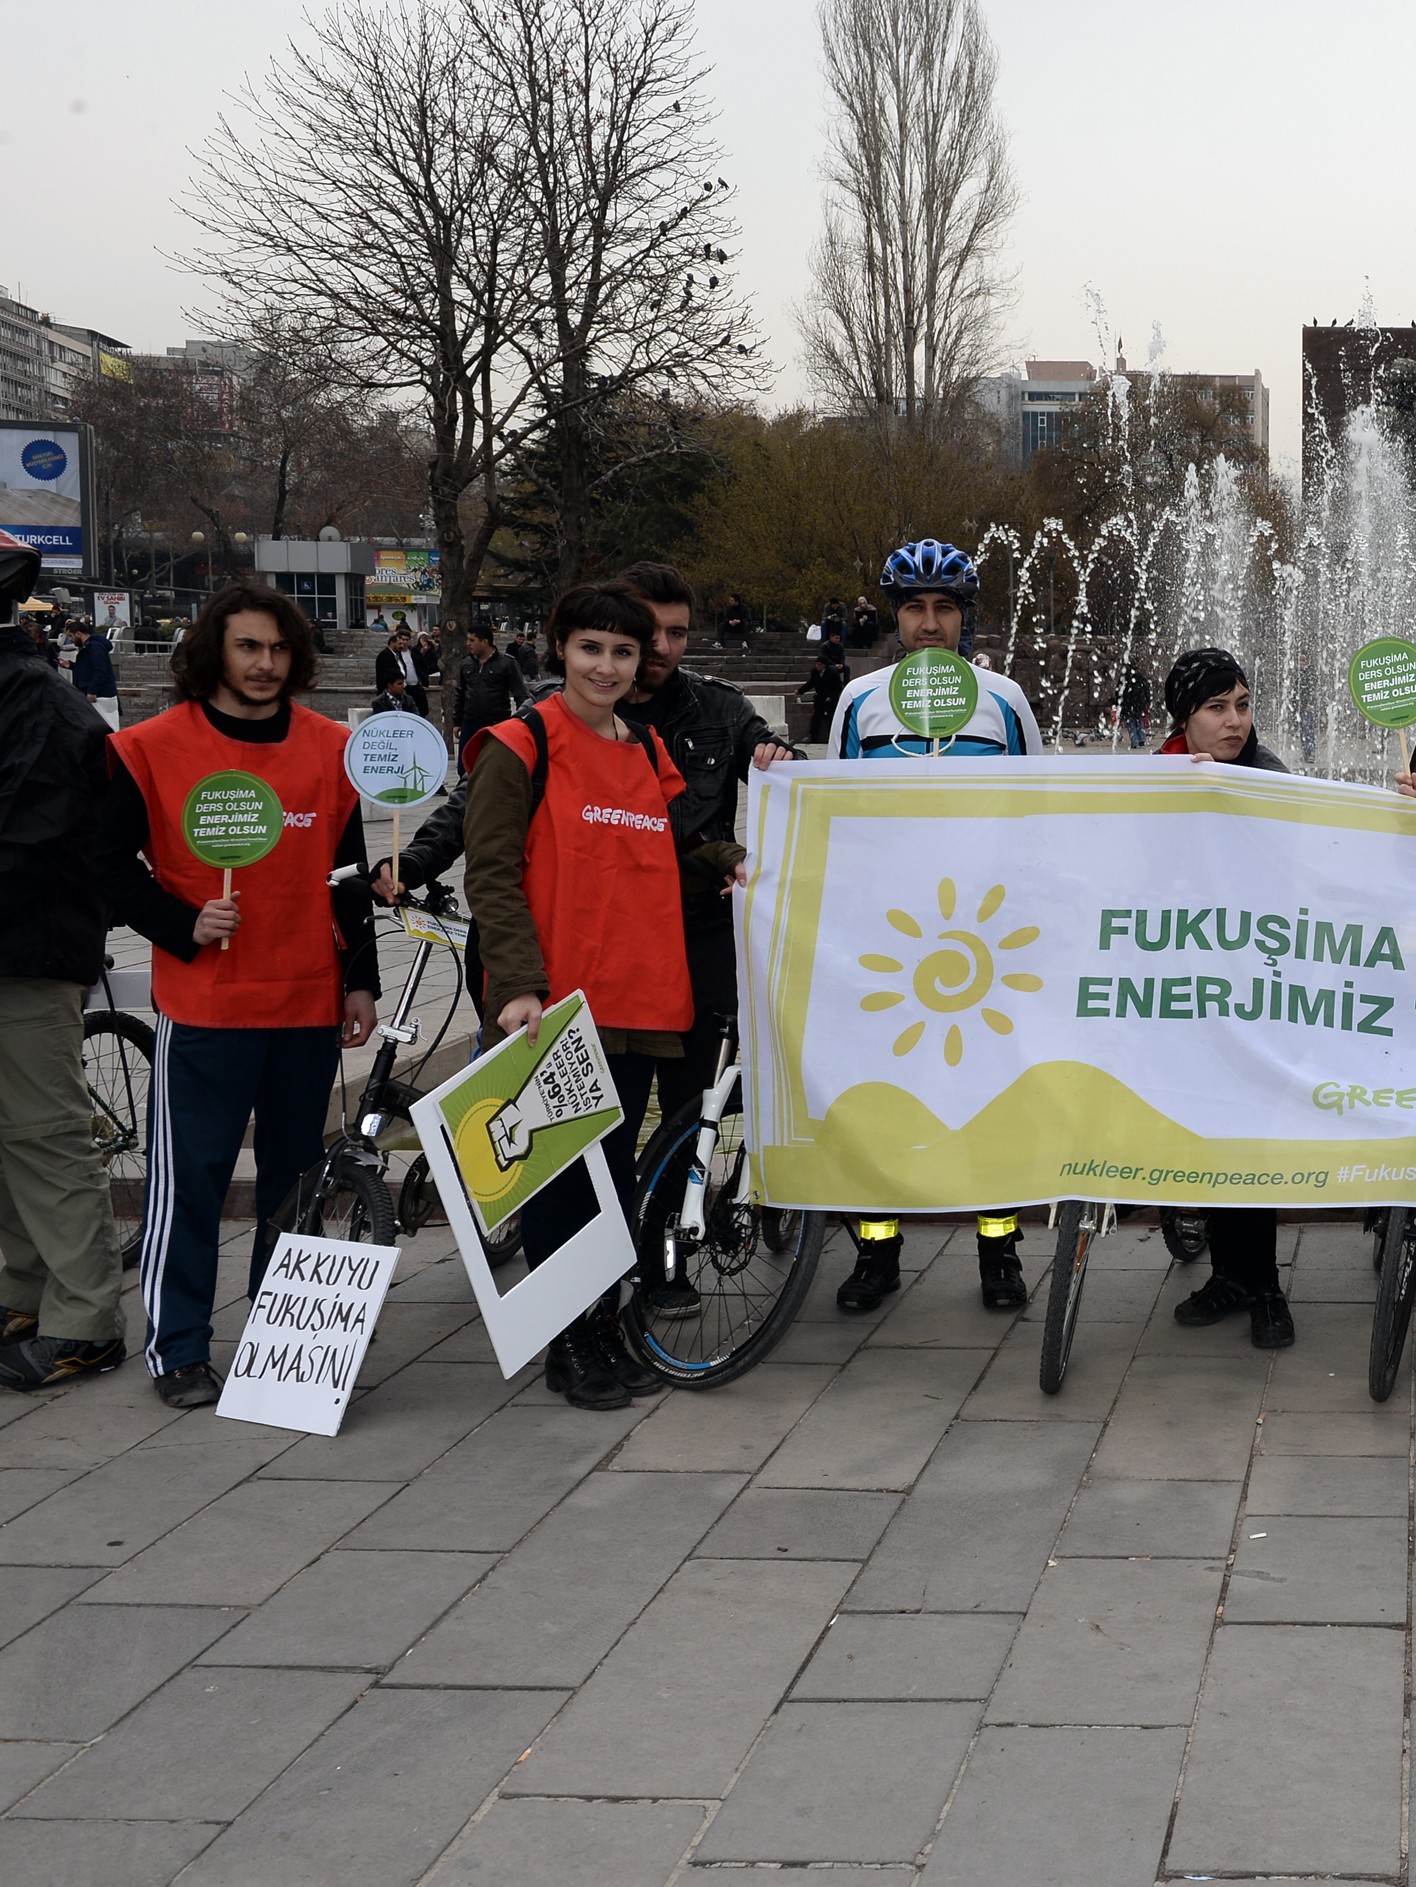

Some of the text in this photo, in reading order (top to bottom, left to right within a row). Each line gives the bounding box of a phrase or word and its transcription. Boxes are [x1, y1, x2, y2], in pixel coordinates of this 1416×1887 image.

[15, 534, 73, 545] TURKCELL
[1361, 652, 1409, 669] FUKUŞİMA
[906, 664, 956, 676] FUKUŞİMA
[1358, 662, 1416, 681] DERS OLSUN
[902, 676, 962, 687] DERS OLSUN
[1364, 673, 1416, 691] ENERJİMİZ
[906, 686, 959, 698] ENERJİMİZ
[1361, 690, 1390, 703] TEMİZ
[901, 698, 966, 709] TEMİZ OLSUN
[362, 728, 414, 738] NÜKLEER
[362, 740, 398, 751] DEĞİL,
[363, 751, 399, 762] TEMİZ
[363, 764, 405, 774] ENERJİ
[201, 788, 256, 801] FUKUŞİMA
[195, 802, 263, 813] DERS OLSUN
[199, 812, 259, 825] ENERJİMİZ
[283, 812, 317, 827] ACE
[581, 804, 667, 832] GREENPEACE
[193, 825, 267, 837] TEMİZ OLSUN
[1099, 907, 1406, 971] FUKUŞİMA
[1076, 970, 1395, 1037] ENERJİMİZ
[560, 1037, 593, 1112] İSTEMİYOR!
[567, 1027, 604, 1109] YA SEN?
[552, 1049, 582, 1114] NÜKLEER
[1059, 1159, 1330, 1189] nukleer.greenpeace.org
[272, 1247, 381, 1291] AKKUYU
[251, 1291, 367, 1340] FUKUŞİMA
[234, 1338, 358, 1405] OLMASIN!
